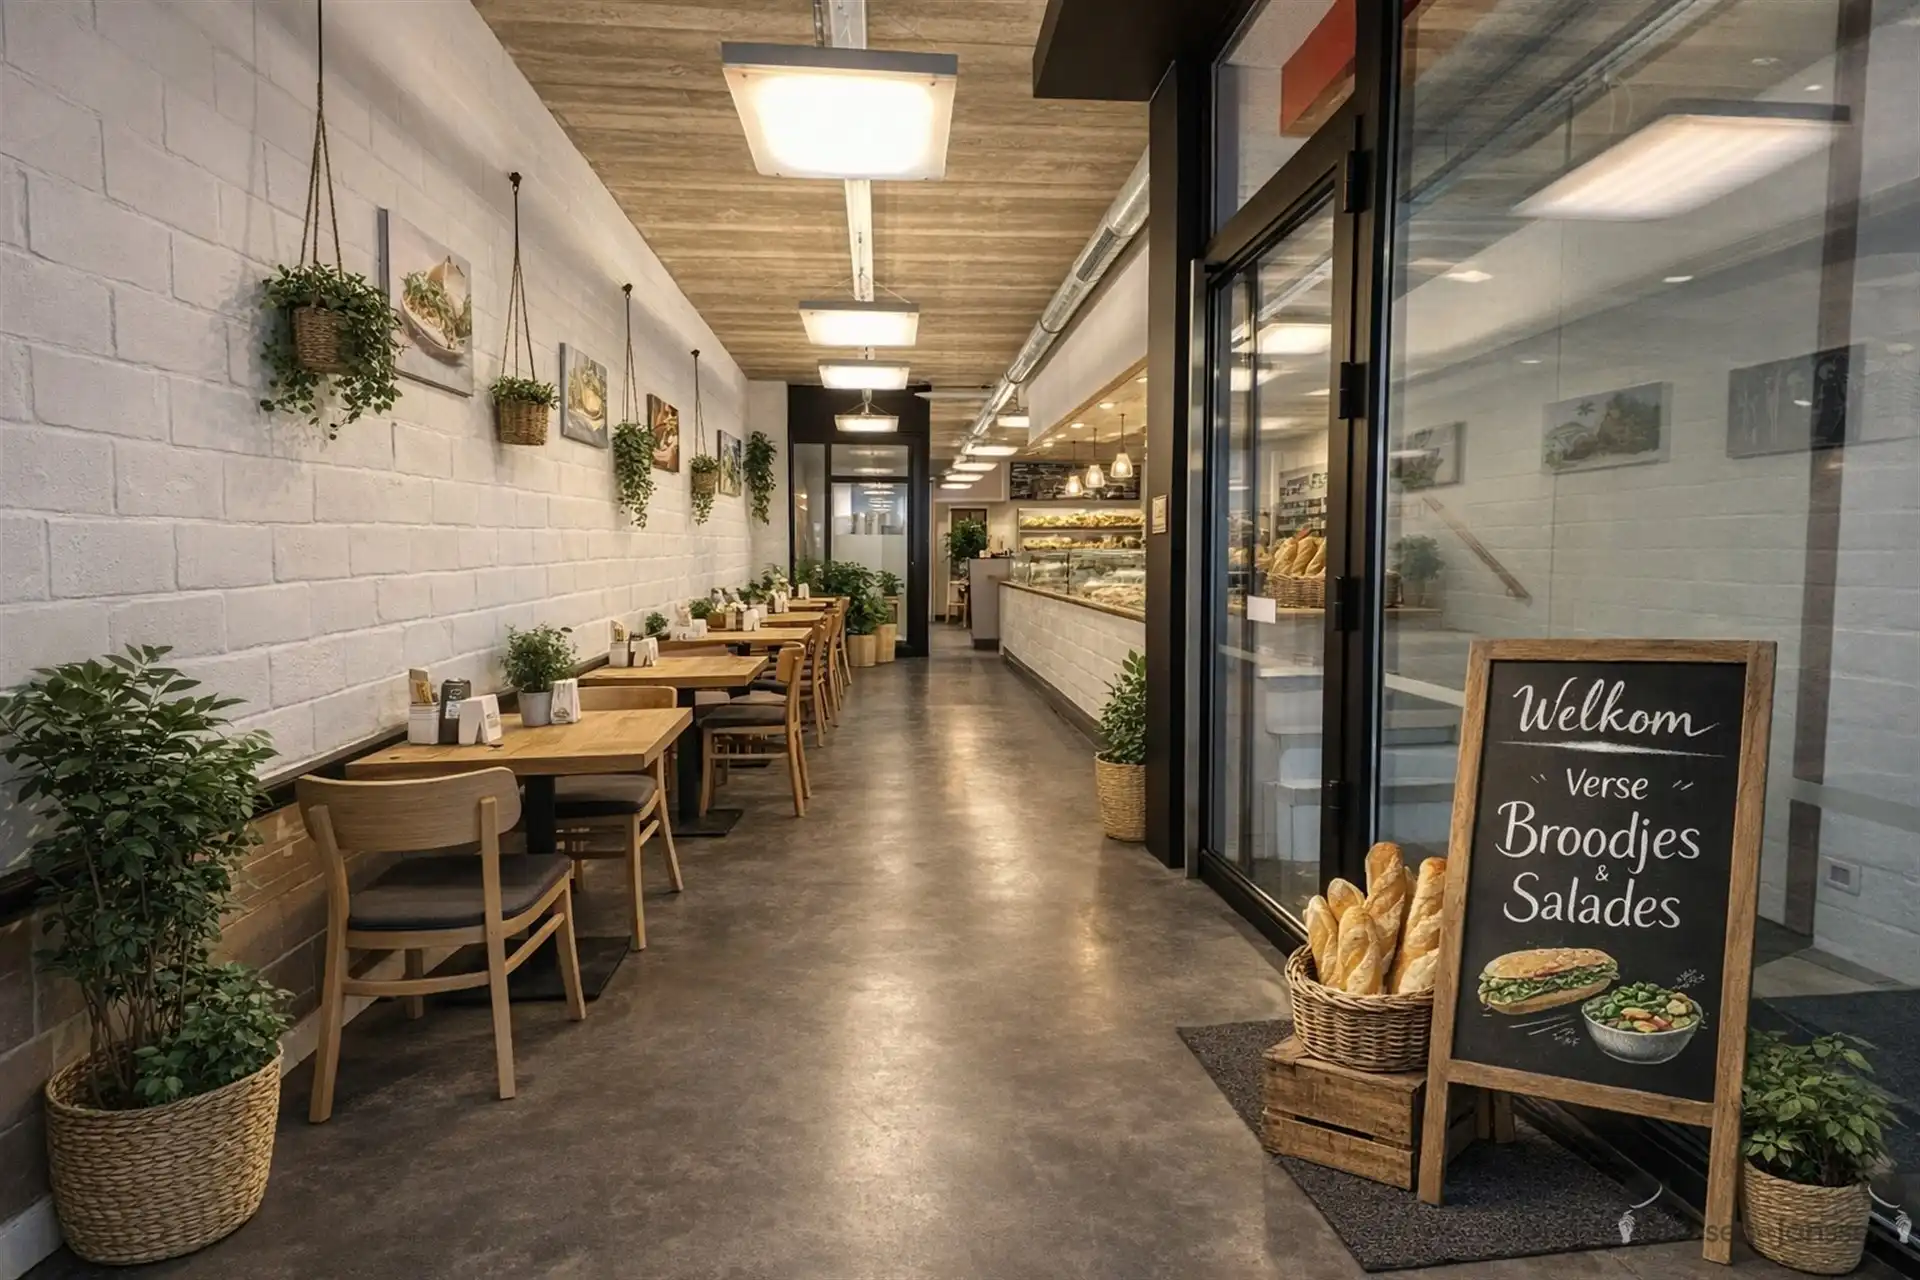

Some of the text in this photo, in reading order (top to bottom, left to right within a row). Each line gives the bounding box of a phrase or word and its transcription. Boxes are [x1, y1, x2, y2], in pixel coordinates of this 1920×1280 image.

[1512, 676, 1719, 738] Welkom
[1566, 767, 1649, 801] Verse
[1494, 800, 1701, 875] Broodjes
[1502, 871, 1682, 929] Salades
[1594, 864, 1609, 882] &
